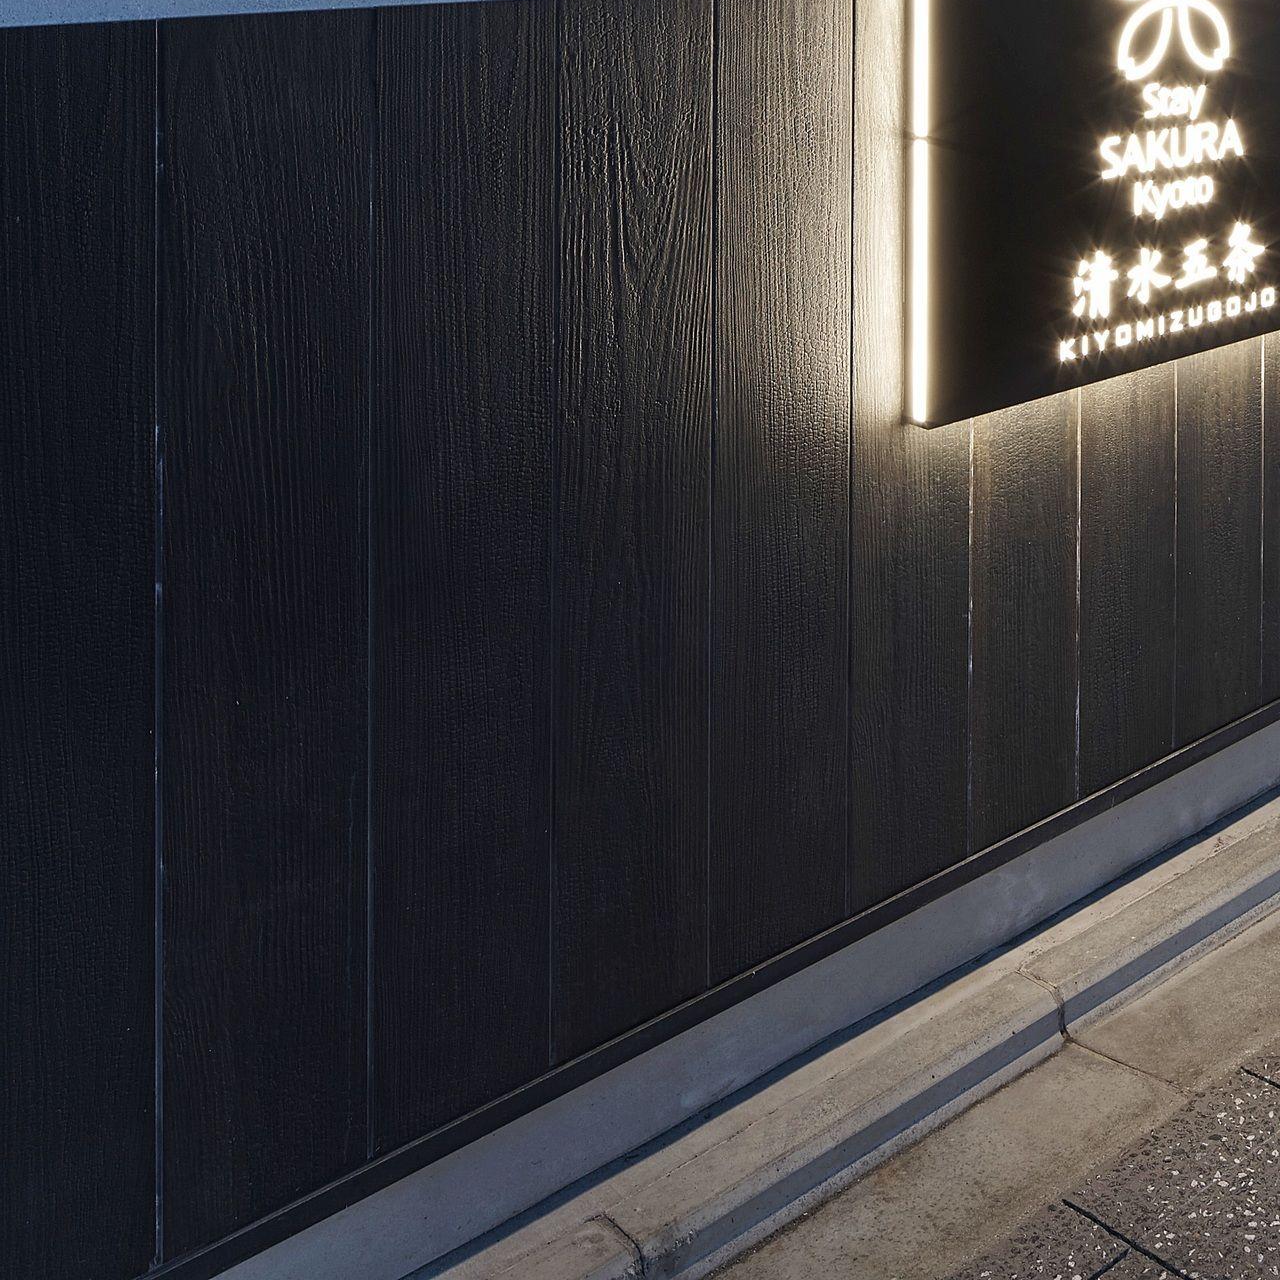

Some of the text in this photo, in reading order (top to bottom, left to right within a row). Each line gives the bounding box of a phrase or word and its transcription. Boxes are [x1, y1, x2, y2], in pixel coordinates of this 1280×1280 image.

[1142, 82, 1207, 120] Stay
[1099, 118, 1245, 180] SAKURA
[1133, 175, 1215, 220] Kyoto
[1072, 221, 1266, 320] 清水五条
[1059, 286, 1276, 362] KIYOMIZUGOJO
